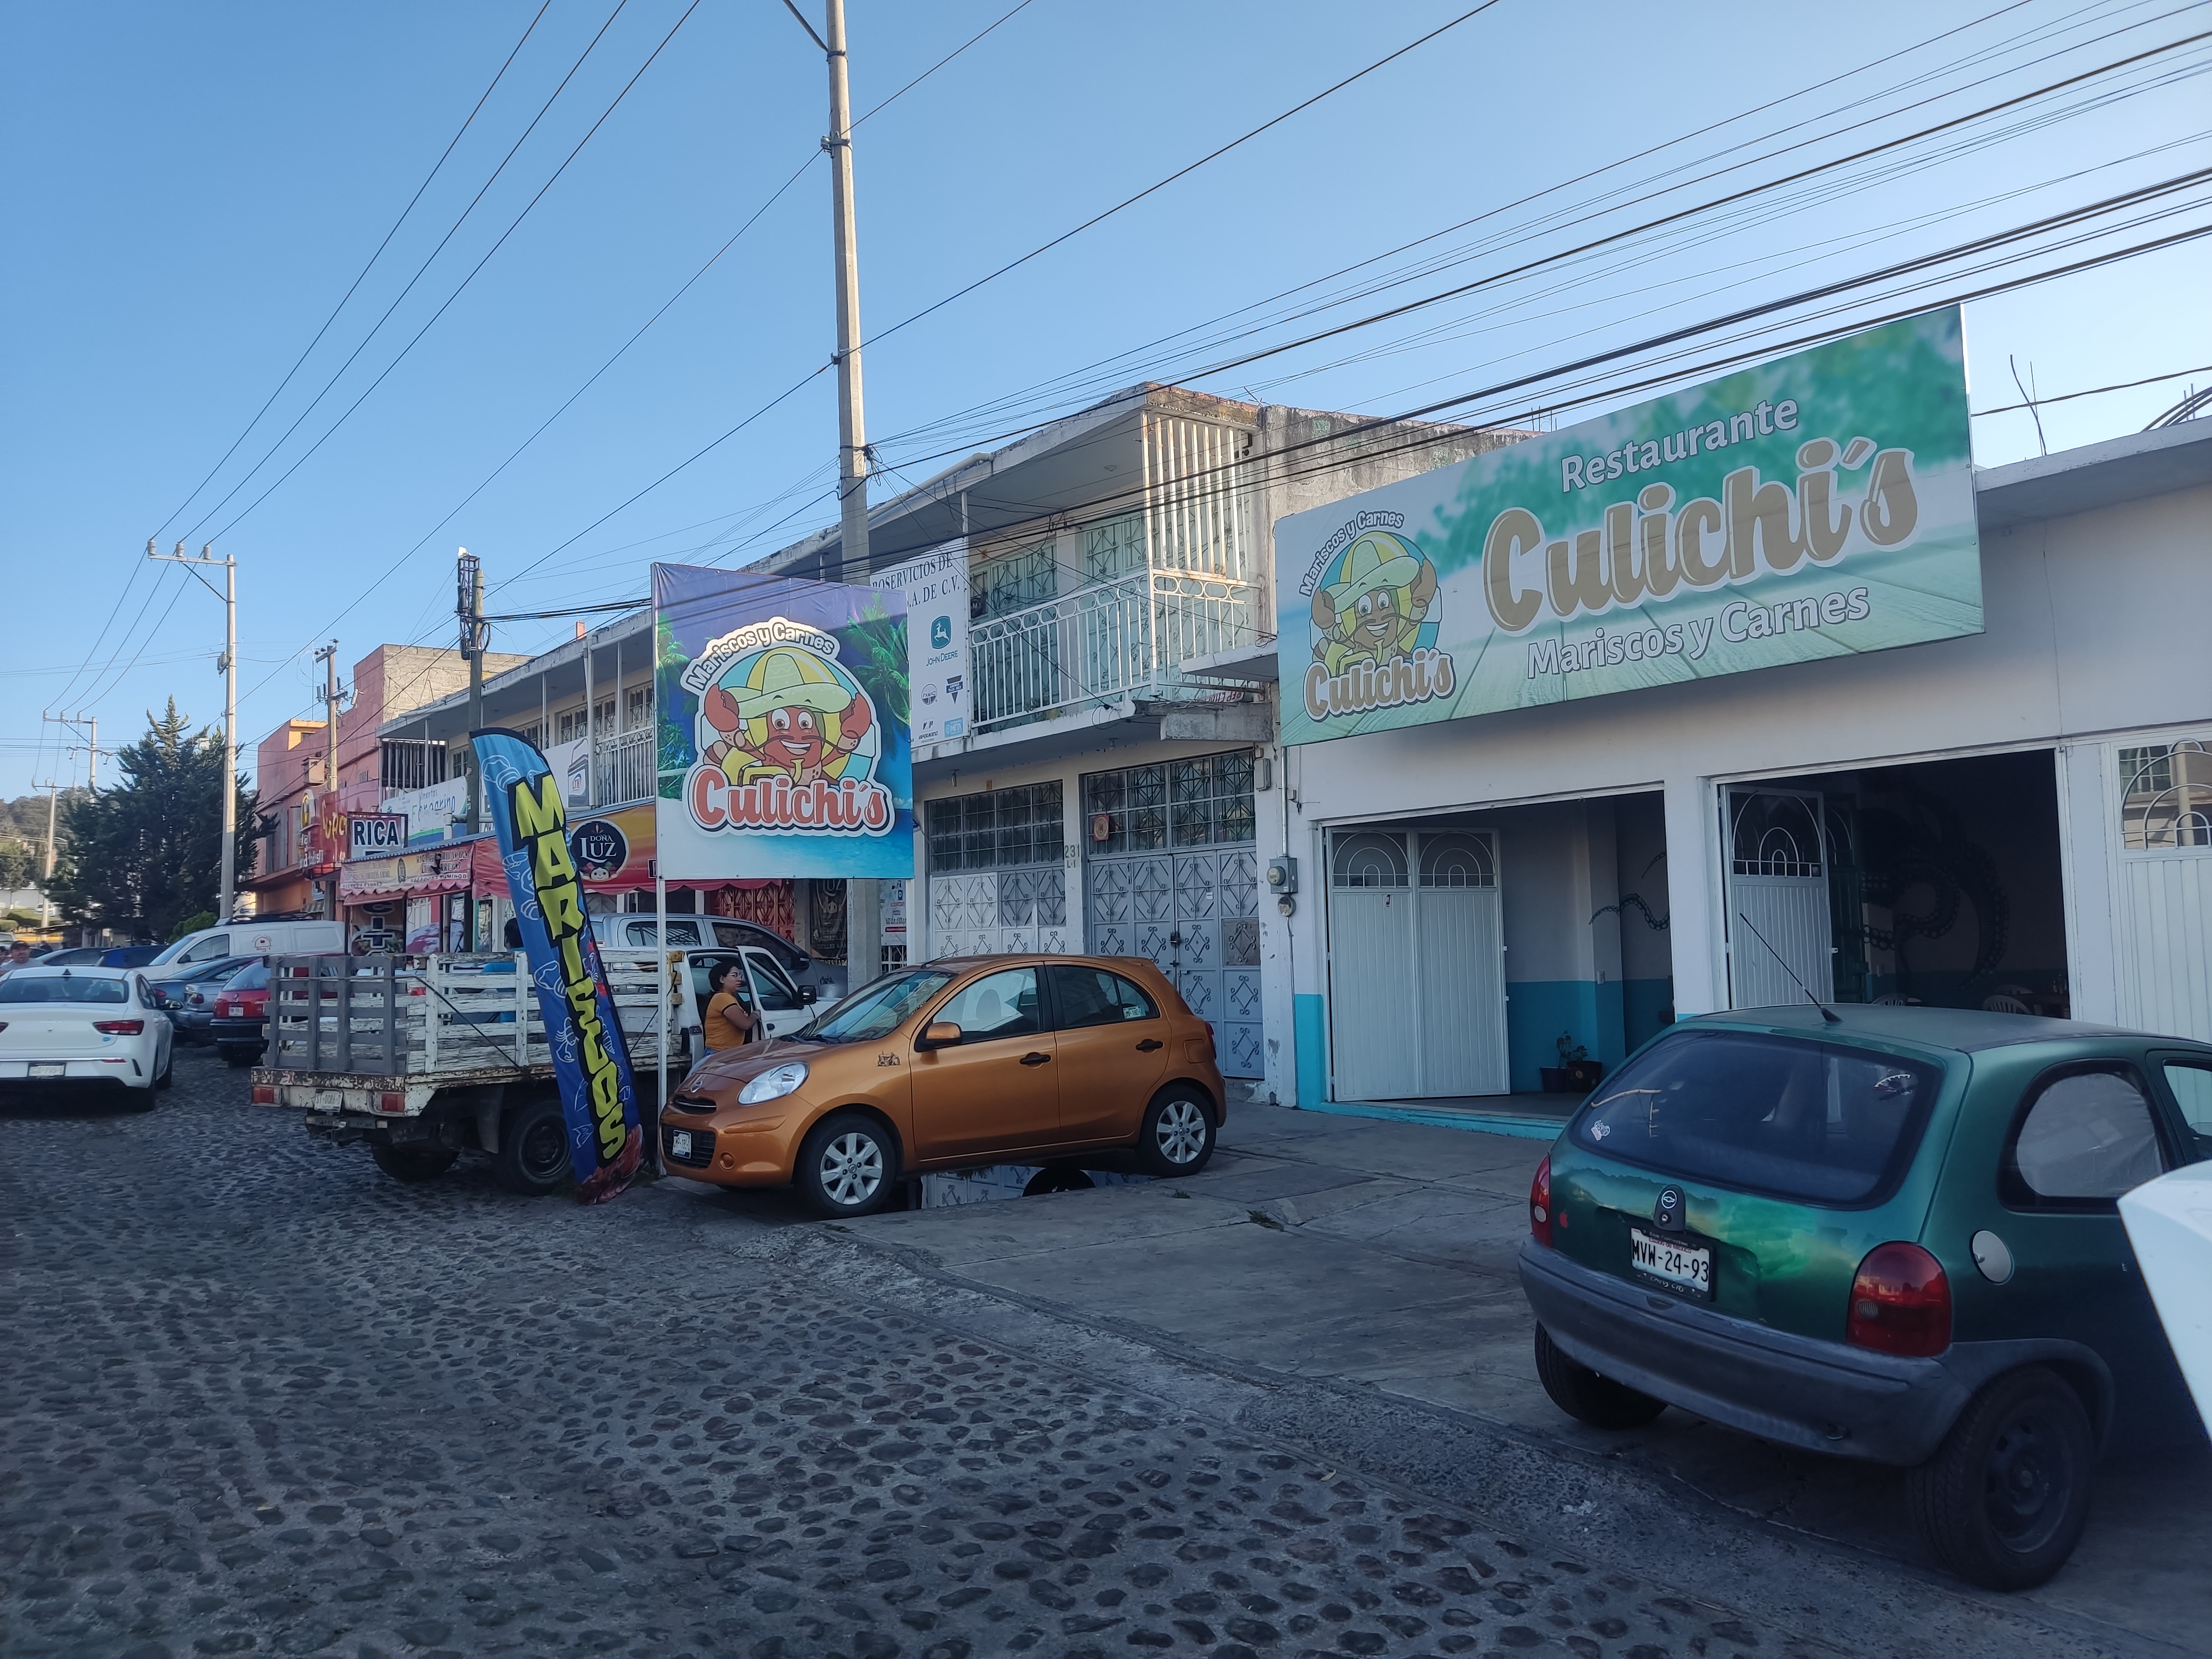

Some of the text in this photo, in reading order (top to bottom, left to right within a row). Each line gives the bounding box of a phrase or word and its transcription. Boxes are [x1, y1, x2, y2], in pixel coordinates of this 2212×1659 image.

[1561, 399, 1798, 493] Restaurante
[938, 553, 953, 572] DE
[1299, 510, 1405, 597] Mariscos y Carnes
[923, 583, 937, 603] DE
[942, 574, 960, 595] C.V.
[1527, 587, 1870, 679] Mariscos y Carnes
[686, 622, 834, 691] Mariscos y Carnes
[926, 650, 958, 666] JOHN DEERE
[353, 821, 399, 847] RICA
[579, 837, 617, 863] LUZ
[1065, 844, 1079, 858] 231
[512, 773, 629, 1162] MARISCOS
[1632, 1239, 1709, 1282] MVW-24-93
